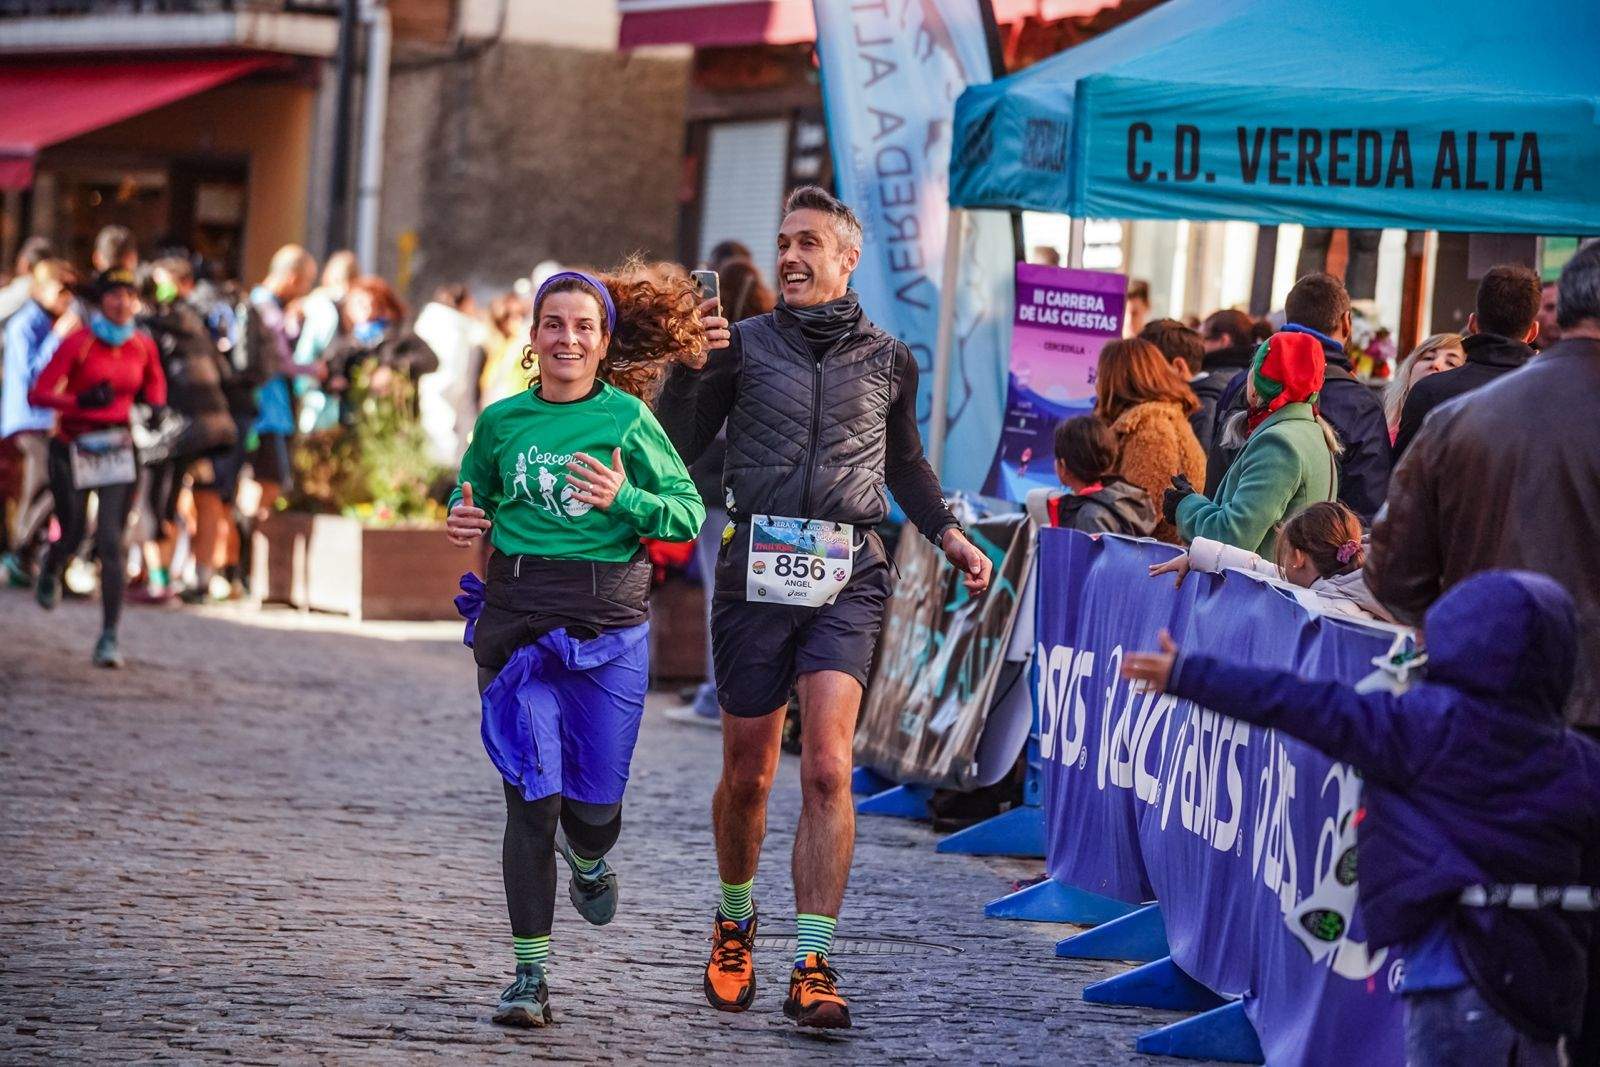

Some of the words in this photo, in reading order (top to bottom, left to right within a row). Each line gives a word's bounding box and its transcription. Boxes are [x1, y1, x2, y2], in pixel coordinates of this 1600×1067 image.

[1127, 122, 1215, 182] C.D.
[1237, 126, 1414, 188] VEREDA
[1432, 130, 1543, 191] ALTA
[1033, 289, 1045, 304] III
[1046, 290, 1104, 312] CARRERA
[1020, 304, 1036, 321] DE
[1037, 307, 1059, 324] LAS
[1061, 310, 1117, 331] CUESTAS
[774, 554, 826, 581] 856
[1180, 701, 1250, 852] asics
